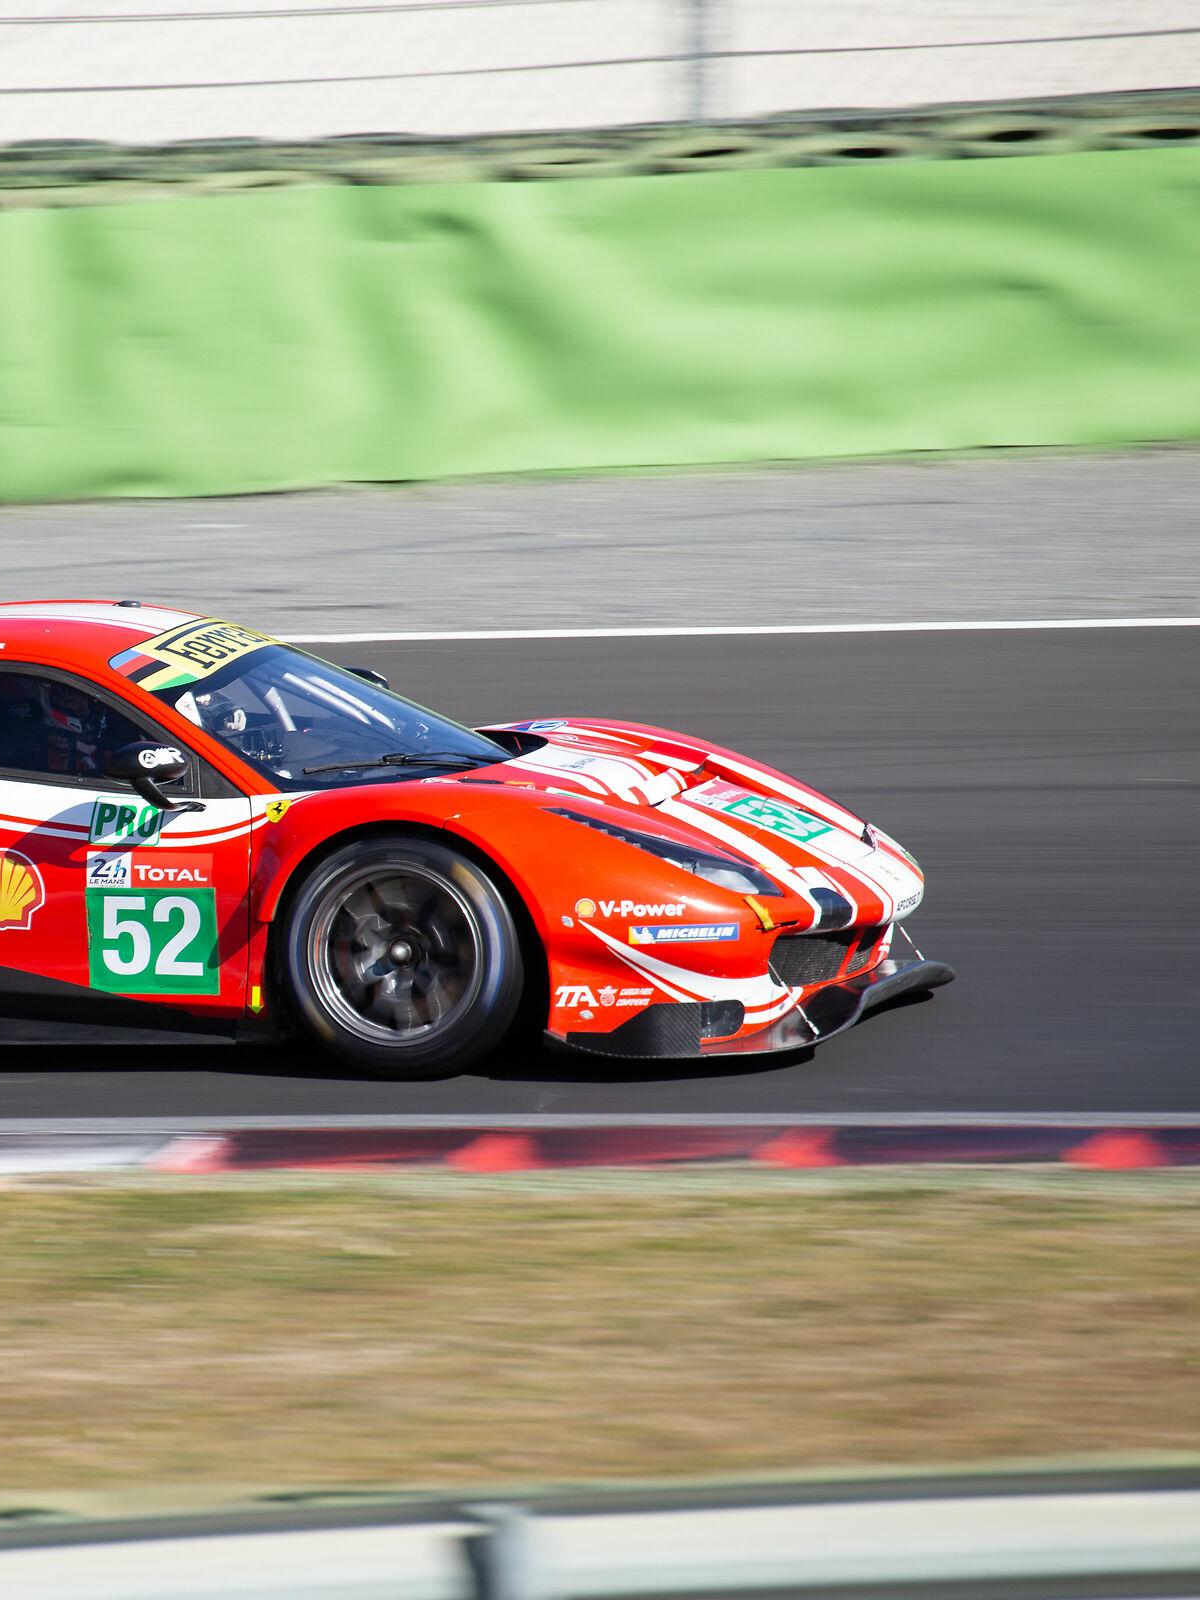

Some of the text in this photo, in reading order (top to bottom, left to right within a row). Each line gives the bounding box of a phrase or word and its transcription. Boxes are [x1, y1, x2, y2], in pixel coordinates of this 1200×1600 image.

[154, 621, 271, 670] Ferra
[94, 802, 159, 838] PRO
[133, 864, 209, 882] TOTAL
[598, 900, 686, 918] V-Power
[102, 895, 204, 977] 52
[656, 926, 735, 939] MICHELIN
